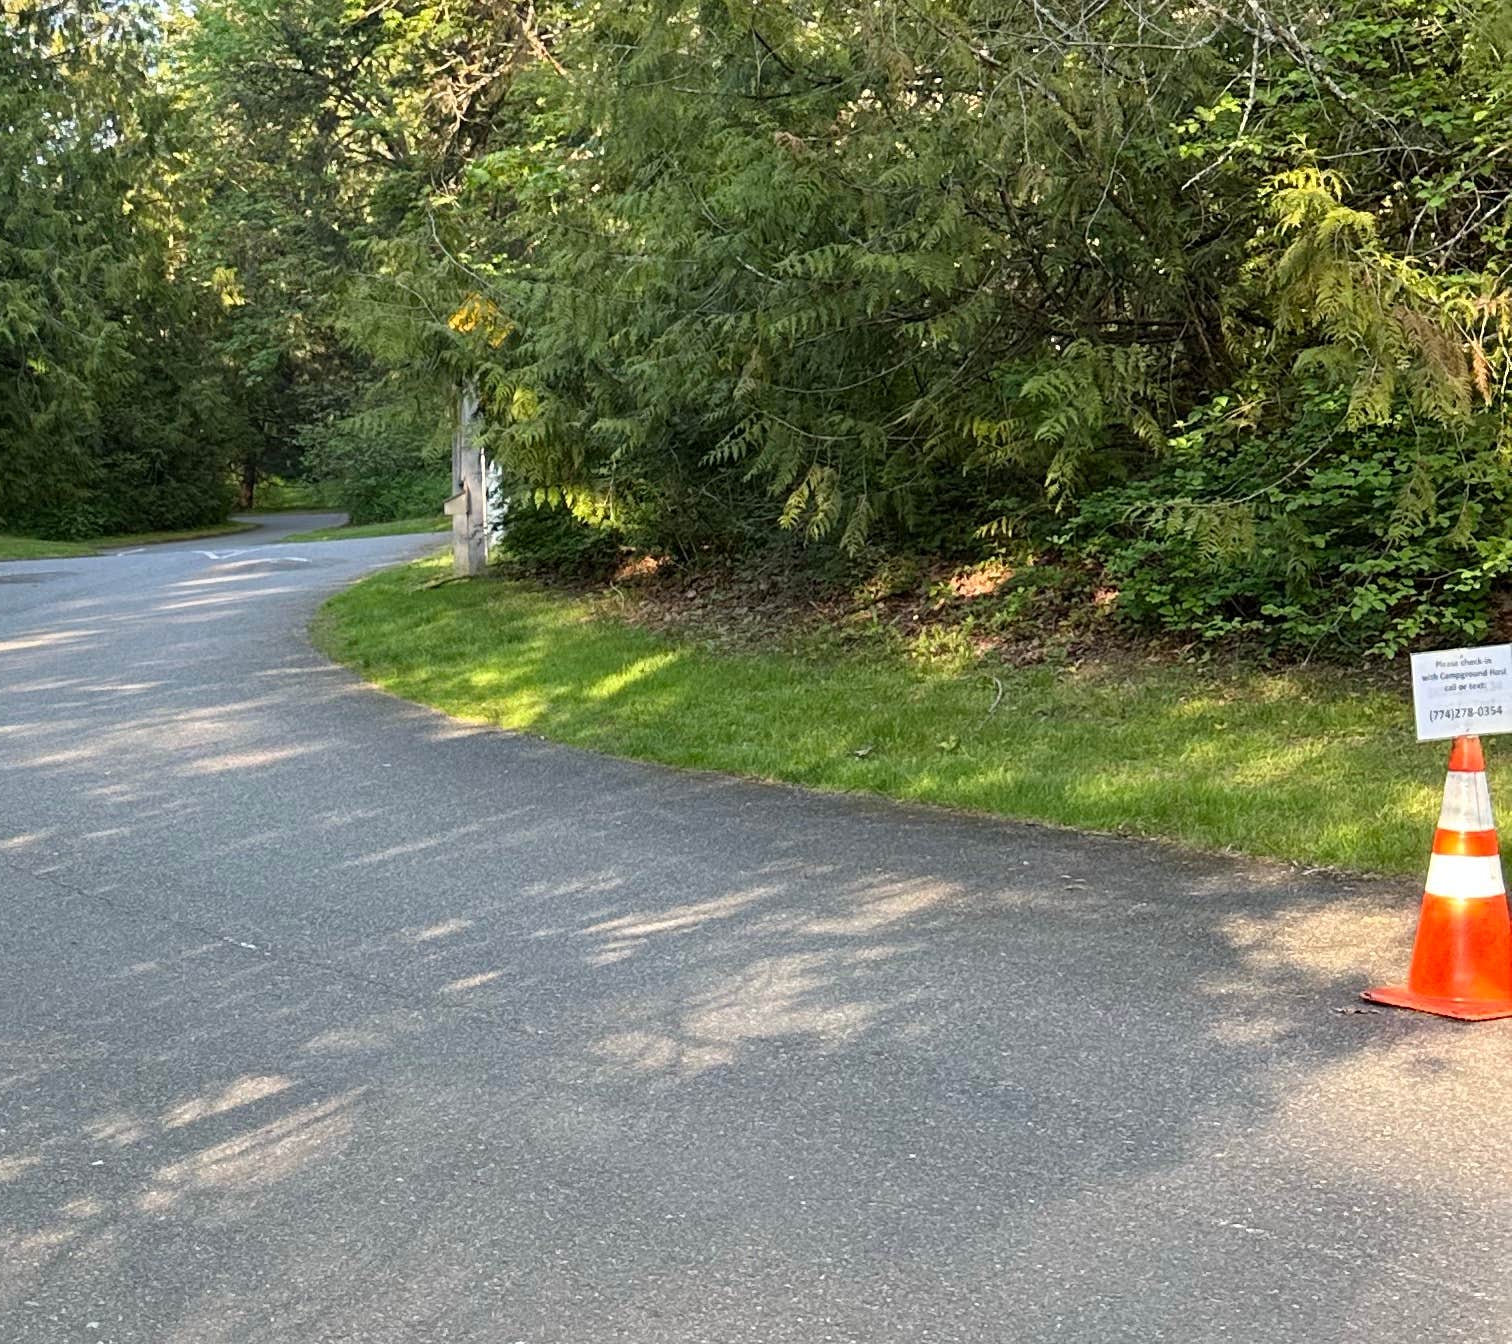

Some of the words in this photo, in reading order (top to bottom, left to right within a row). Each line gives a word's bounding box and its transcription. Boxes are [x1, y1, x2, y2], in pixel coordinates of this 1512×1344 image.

[1436, 660, 1458, 668] Please
[1460, 657, 1492, 666] check-in
[1422, 672, 1438, 681] with
[1440, 670, 1488, 681] Campground
[1490, 668, 1506, 676] Host
[1444, 684, 1457, 692] call
[1430, 706, 1503, 722] (774)278-0354
